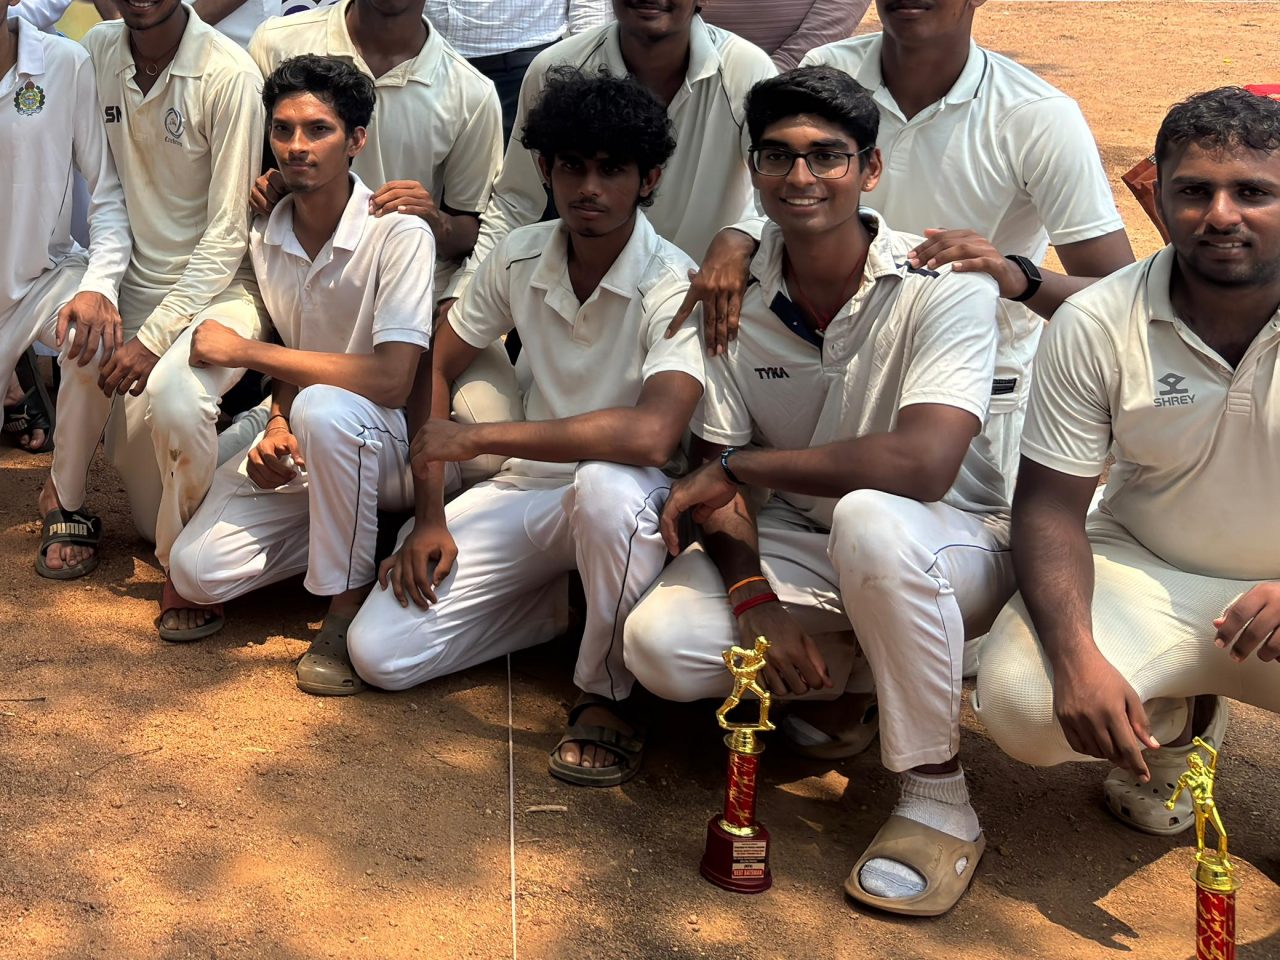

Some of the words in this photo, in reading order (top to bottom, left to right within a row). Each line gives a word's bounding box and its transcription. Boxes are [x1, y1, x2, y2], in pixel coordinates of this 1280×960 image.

[754, 367, 790, 380] TYKA
[1153, 394, 1195, 407] SHREY
[48, 522, 88, 536] PUMA
